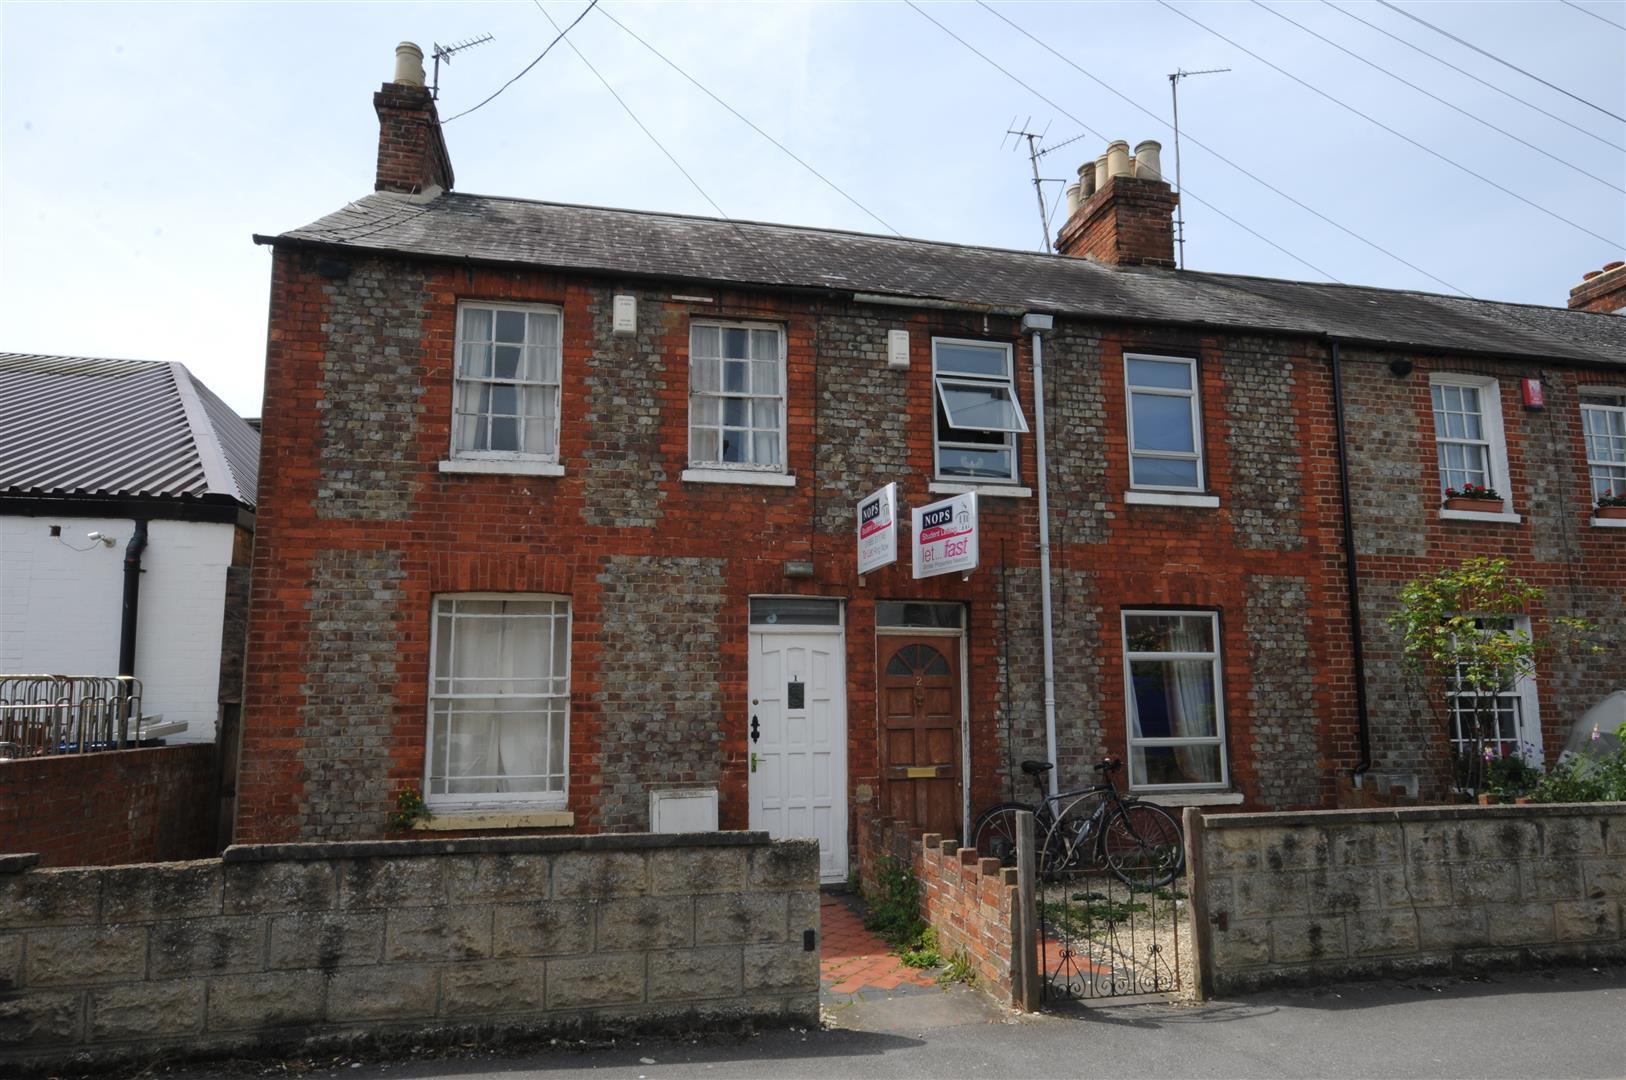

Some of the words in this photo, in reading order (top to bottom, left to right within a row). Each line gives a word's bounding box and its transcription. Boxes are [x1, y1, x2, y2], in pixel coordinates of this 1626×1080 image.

[863, 503, 879, 521] NOPS
[924, 509, 951, 527] NOPS
[944, 537, 968, 558] fast
